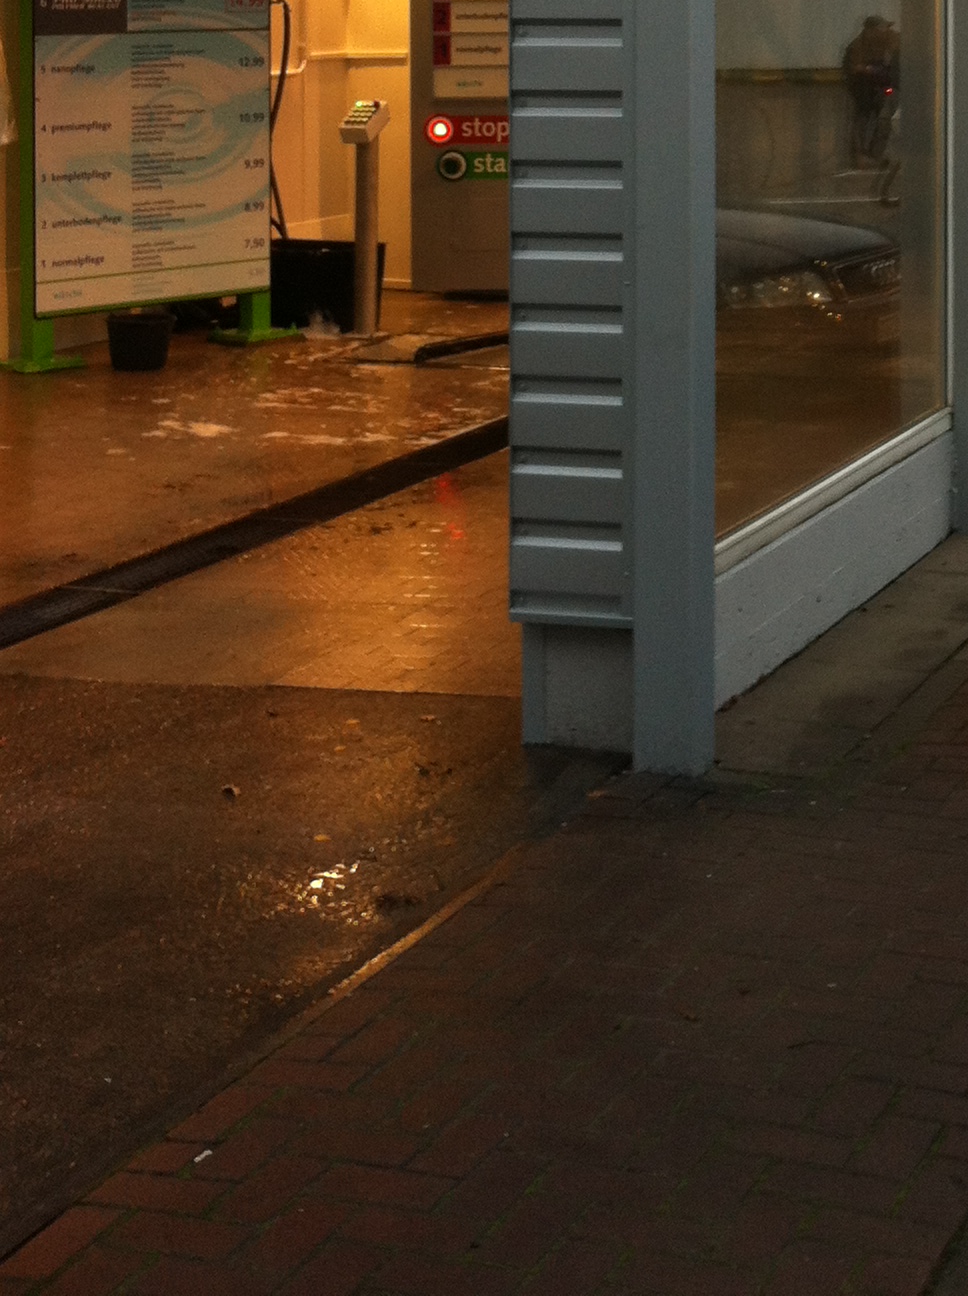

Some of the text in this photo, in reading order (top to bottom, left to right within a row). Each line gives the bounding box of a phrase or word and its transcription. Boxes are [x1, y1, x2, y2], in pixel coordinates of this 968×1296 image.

[51, 65, 96, 75] nanopflege
[41, 121, 112, 134] 4 premiumpflege
[461, 117, 509, 142] stop
[473, 153, 507, 172] sta
[51, 170, 112, 183] komplettpflege
[51, 214, 122, 229] unterbodenpflege
[51, 255, 105, 268] normalpflege
